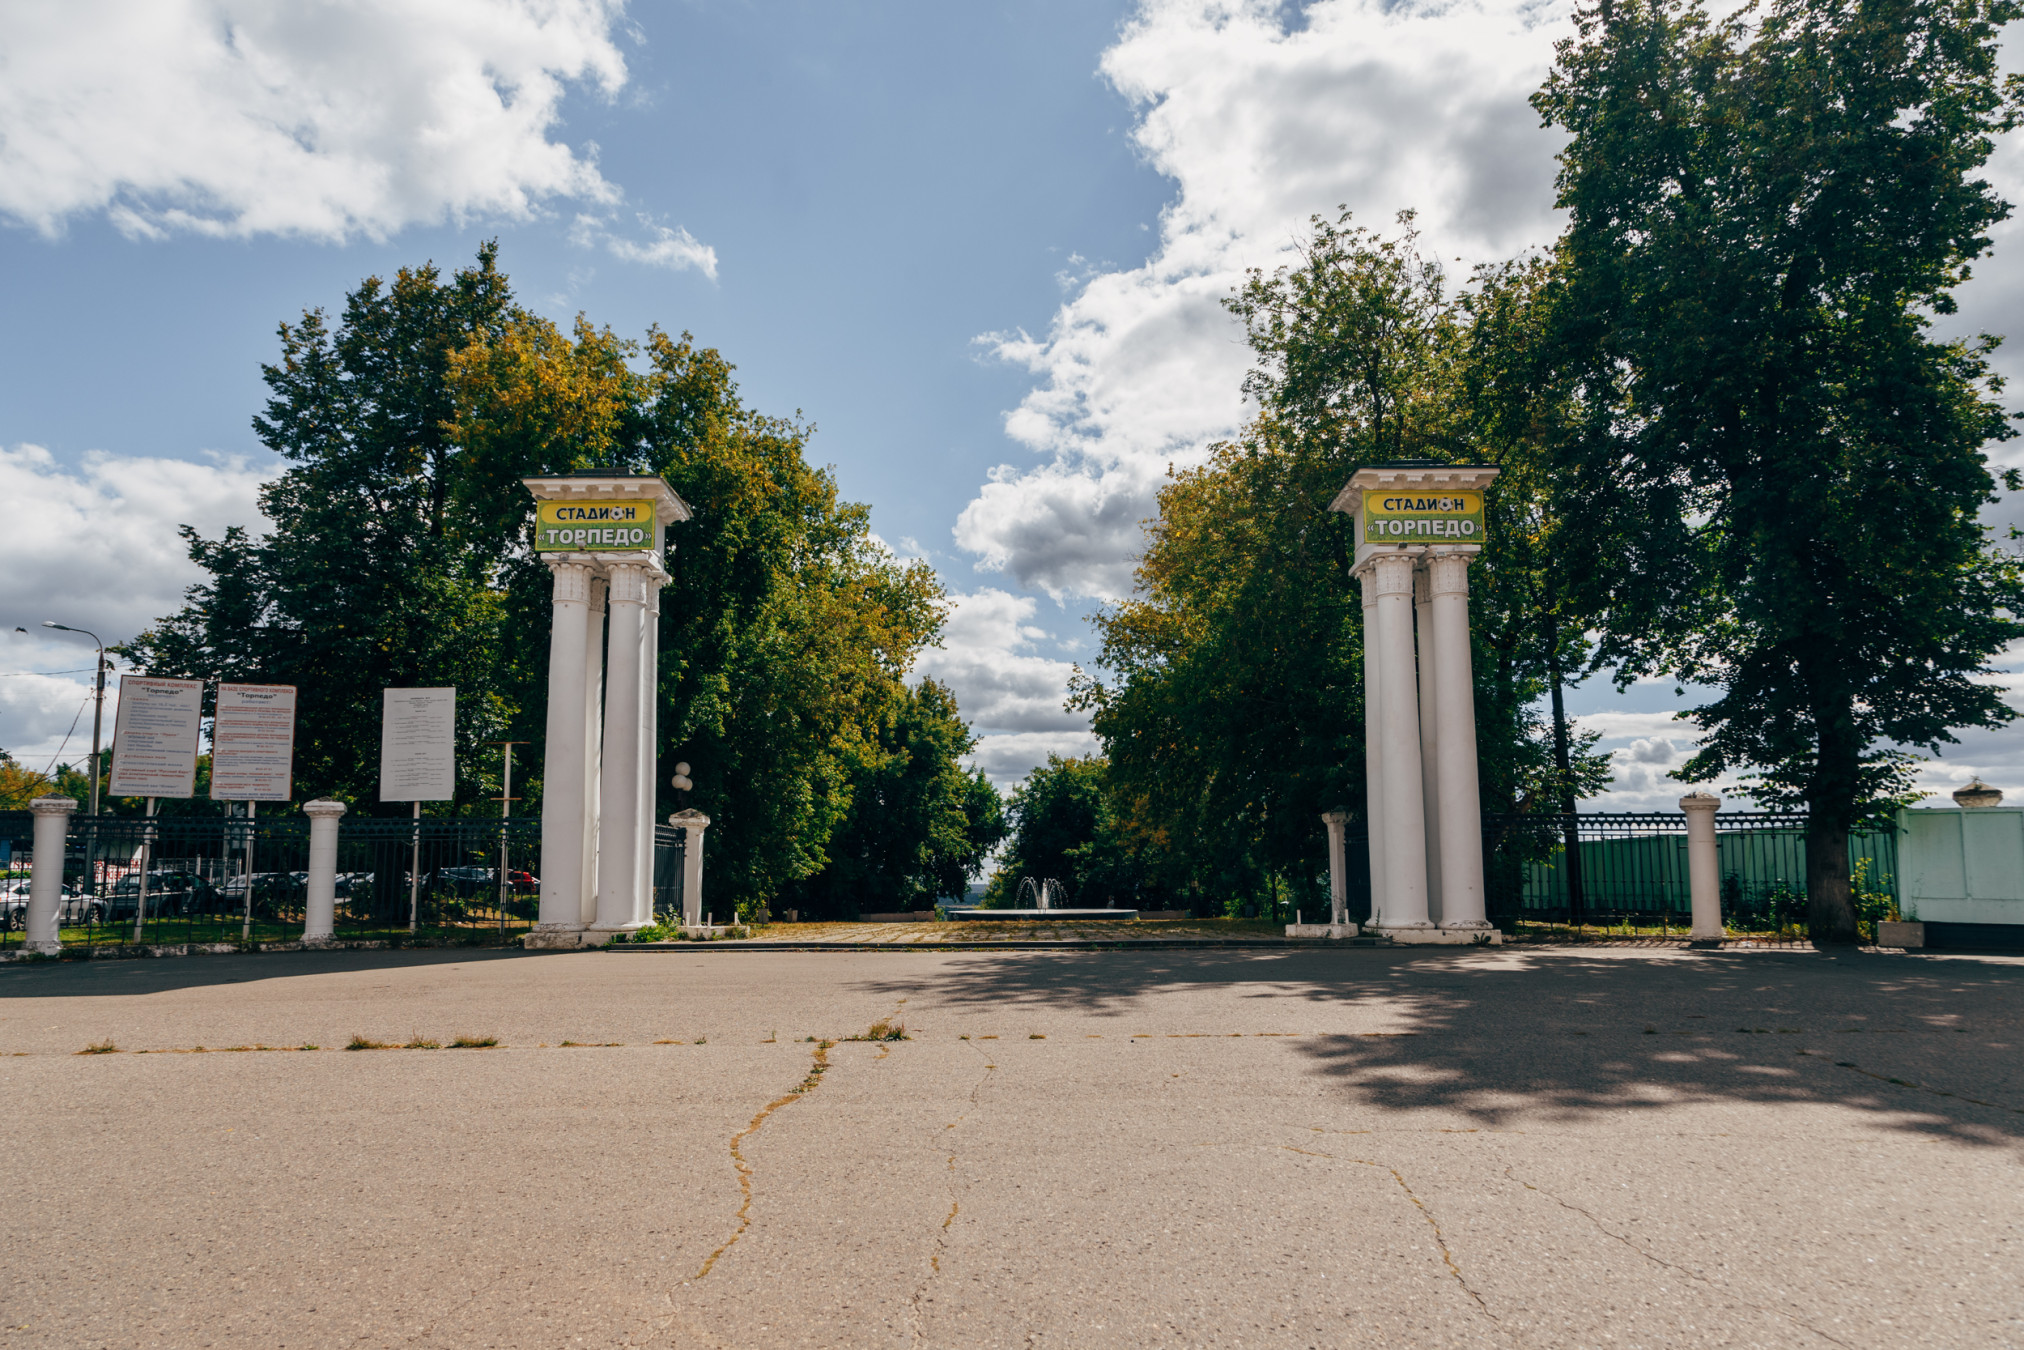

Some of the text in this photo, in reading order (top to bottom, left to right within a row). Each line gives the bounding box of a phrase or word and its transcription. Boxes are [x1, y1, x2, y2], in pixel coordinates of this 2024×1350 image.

[1367, 519, 1483, 538] «ТОРПЕДО»
[538, 528, 652, 547] «ТОРПЕДО»
[127, 679, 166, 687] СПОРТИВНЫЙ
[141, 687, 184, 695] "Торпедо"
